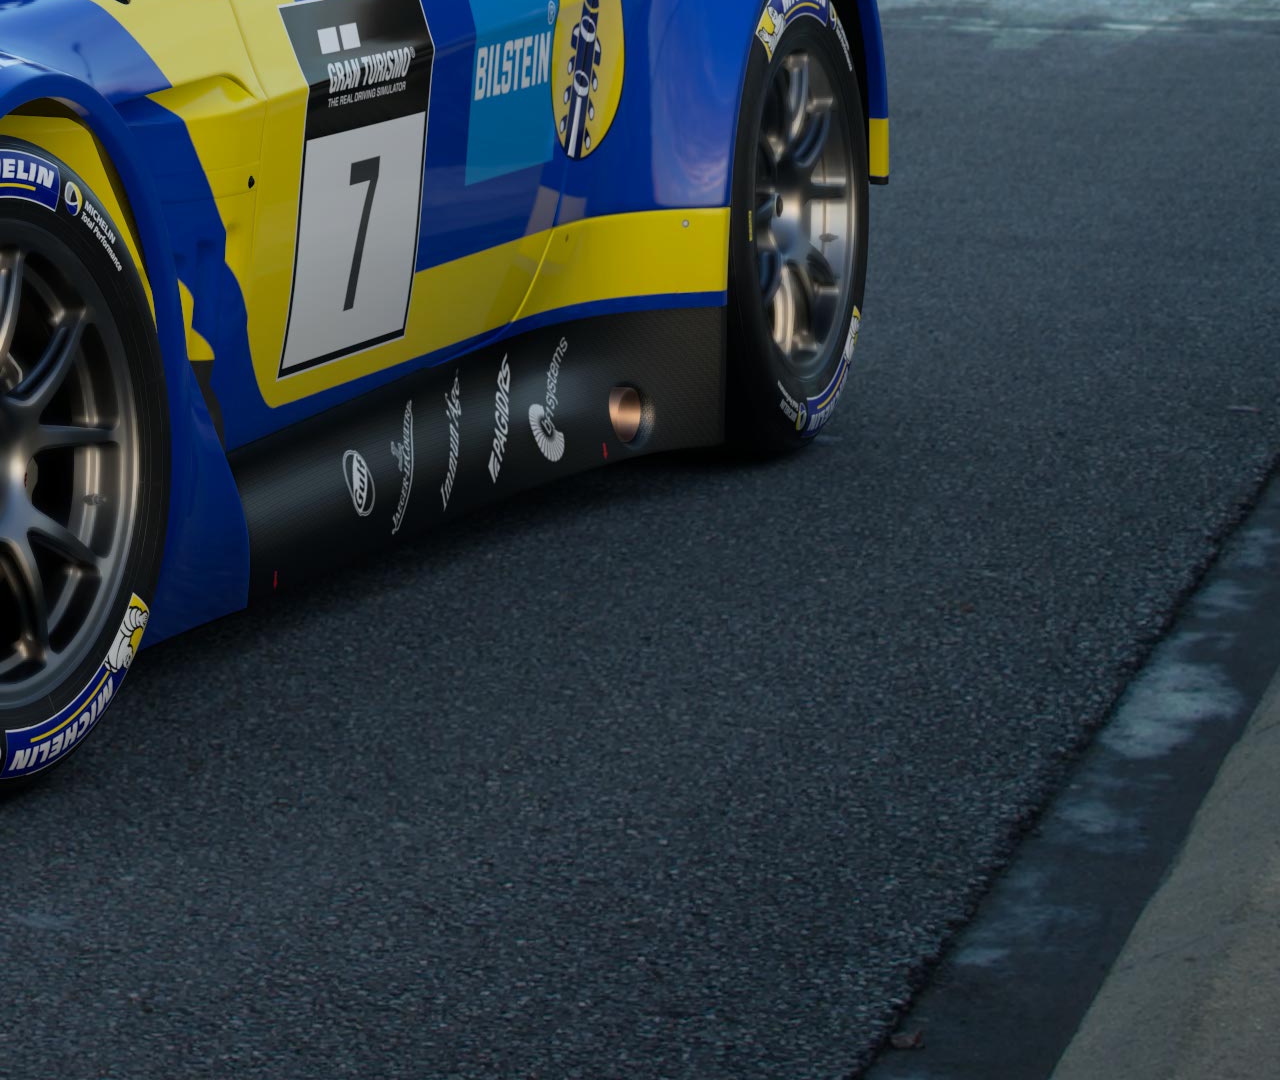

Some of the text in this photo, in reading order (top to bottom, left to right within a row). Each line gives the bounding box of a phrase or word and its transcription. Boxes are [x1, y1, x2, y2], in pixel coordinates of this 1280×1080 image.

[328, 47, 412, 94] GRAN TURISMO
[328, 81, 407, 107] THE REAL DRIVING SIMULATOR
[474, 31, 552, 101] BILSTEIN
[81, 211, 123, 272] Total Performance
[84, 200, 116, 245] MICHELIN
[343, 155, 381, 311] 7
[8, 676, 114, 771] MICHELIN
